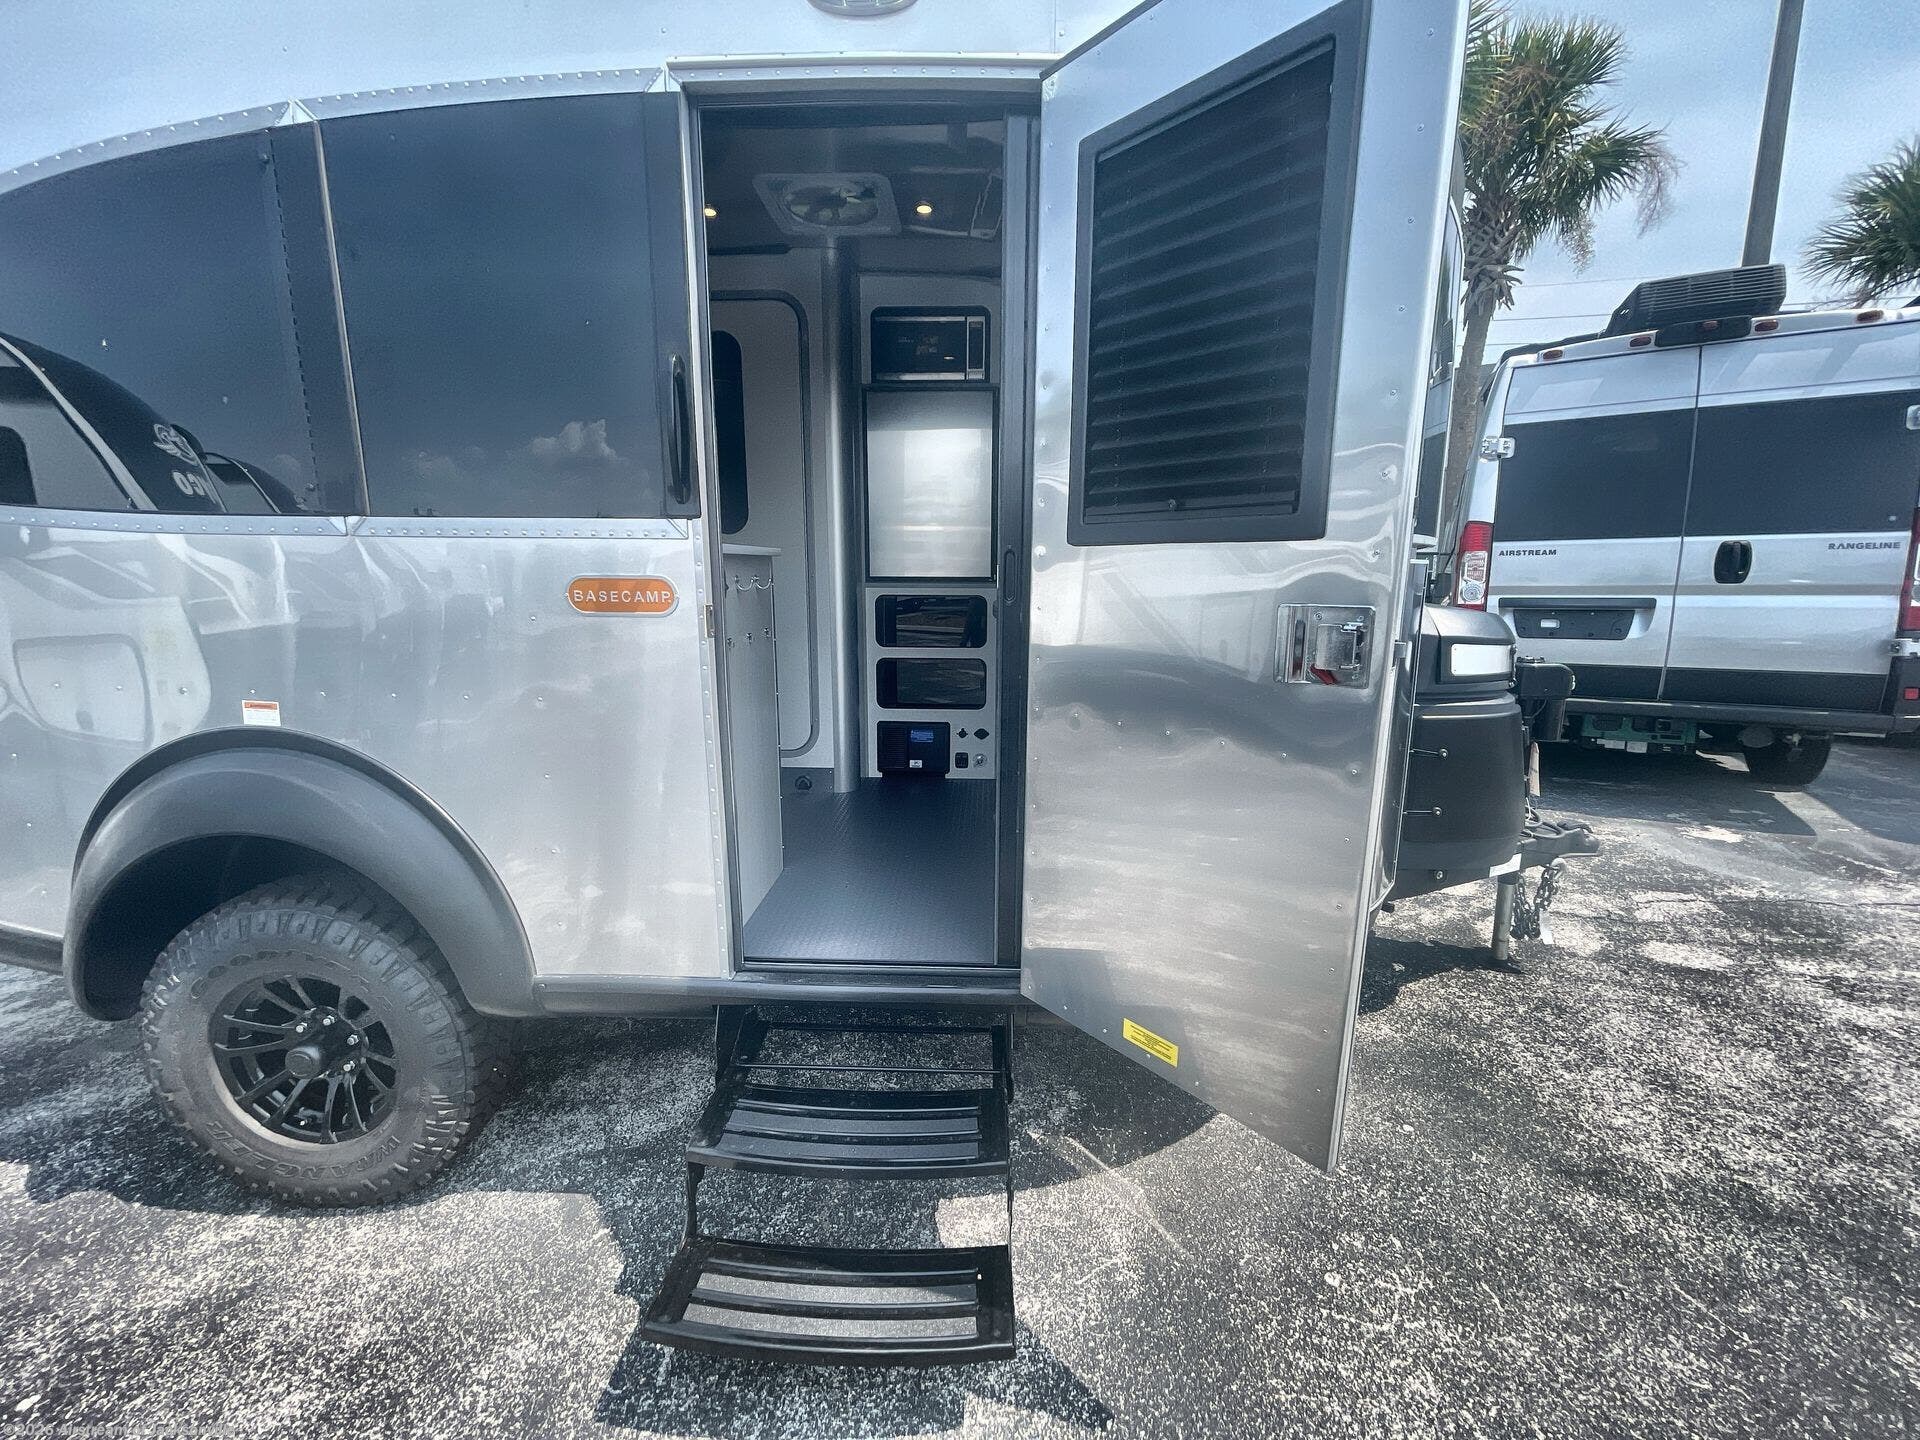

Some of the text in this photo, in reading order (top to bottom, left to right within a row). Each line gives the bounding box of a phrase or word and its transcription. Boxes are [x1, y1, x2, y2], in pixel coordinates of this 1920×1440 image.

[1827, 542, 1902, 550] RANGELINE
[1498, 549, 1557, 557] AIRSTREAM
[573, 590, 671, 603] BASECAMP
